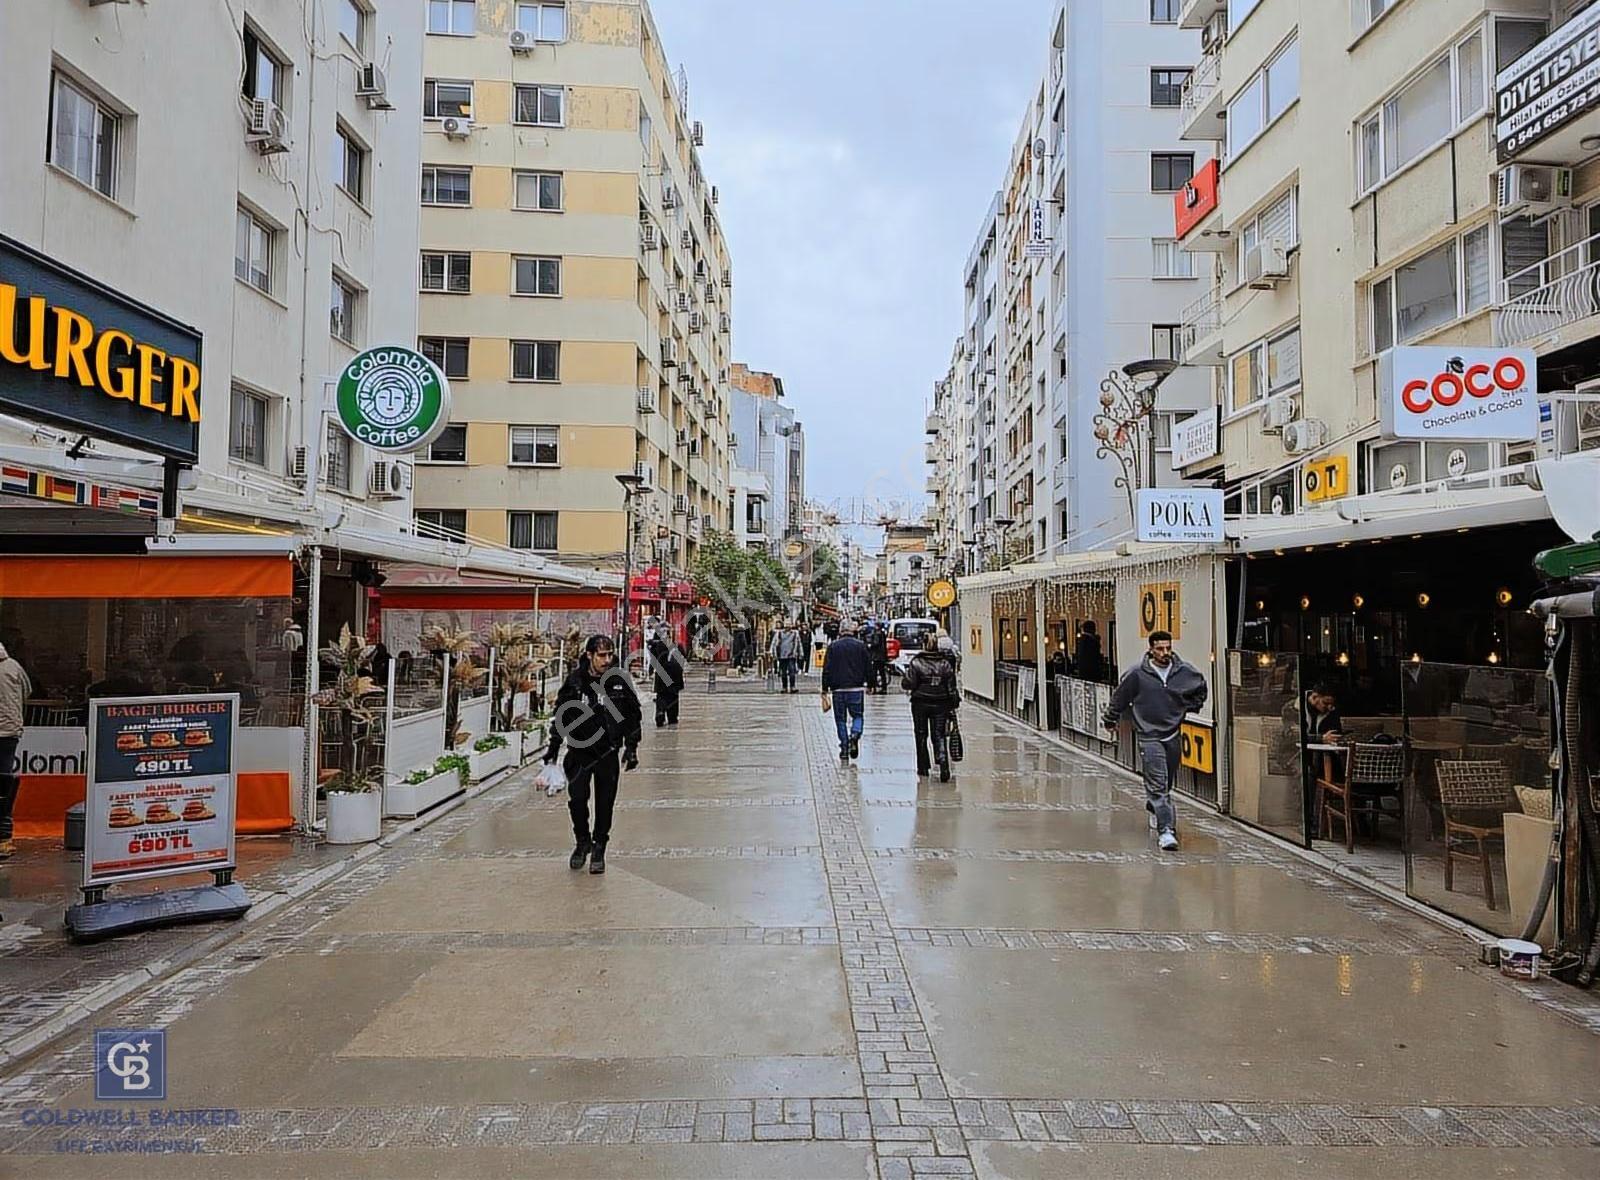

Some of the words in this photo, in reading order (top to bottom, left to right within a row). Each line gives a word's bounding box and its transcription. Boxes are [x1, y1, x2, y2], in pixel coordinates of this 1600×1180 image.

[1501, 27, 1600, 117] DİYETİSYE
[1510, 107, 1532, 130] Hilal
[1536, 96, 1553, 113] Nur
[1507, 138, 1516, 150] 0
[1518, 121, 1541, 145] 544
[1543, 104, 1568, 128] 652
[347, 351, 434, 386] Colombia
[1402, 356, 1526, 414] COCO
[1422, 409, 1477, 430] Chocolate
[1478, 405, 1487, 416] &
[1488, 398, 1523, 413] Cocoa
[356, 423, 420, 446] Coffee
[1305, 464, 1339, 492] OT
[1150, 501, 1212, 527] POKA
[1149, 530, 1172, 538] coffee
[933, 588, 951, 599] OT
[163, 702, 226, 715] BURGER
[134, 760, 170, 773] 490
[172, 759, 193, 771] TL
[128, 837, 168, 854] 690
[170, 835, 193, 849] TL
